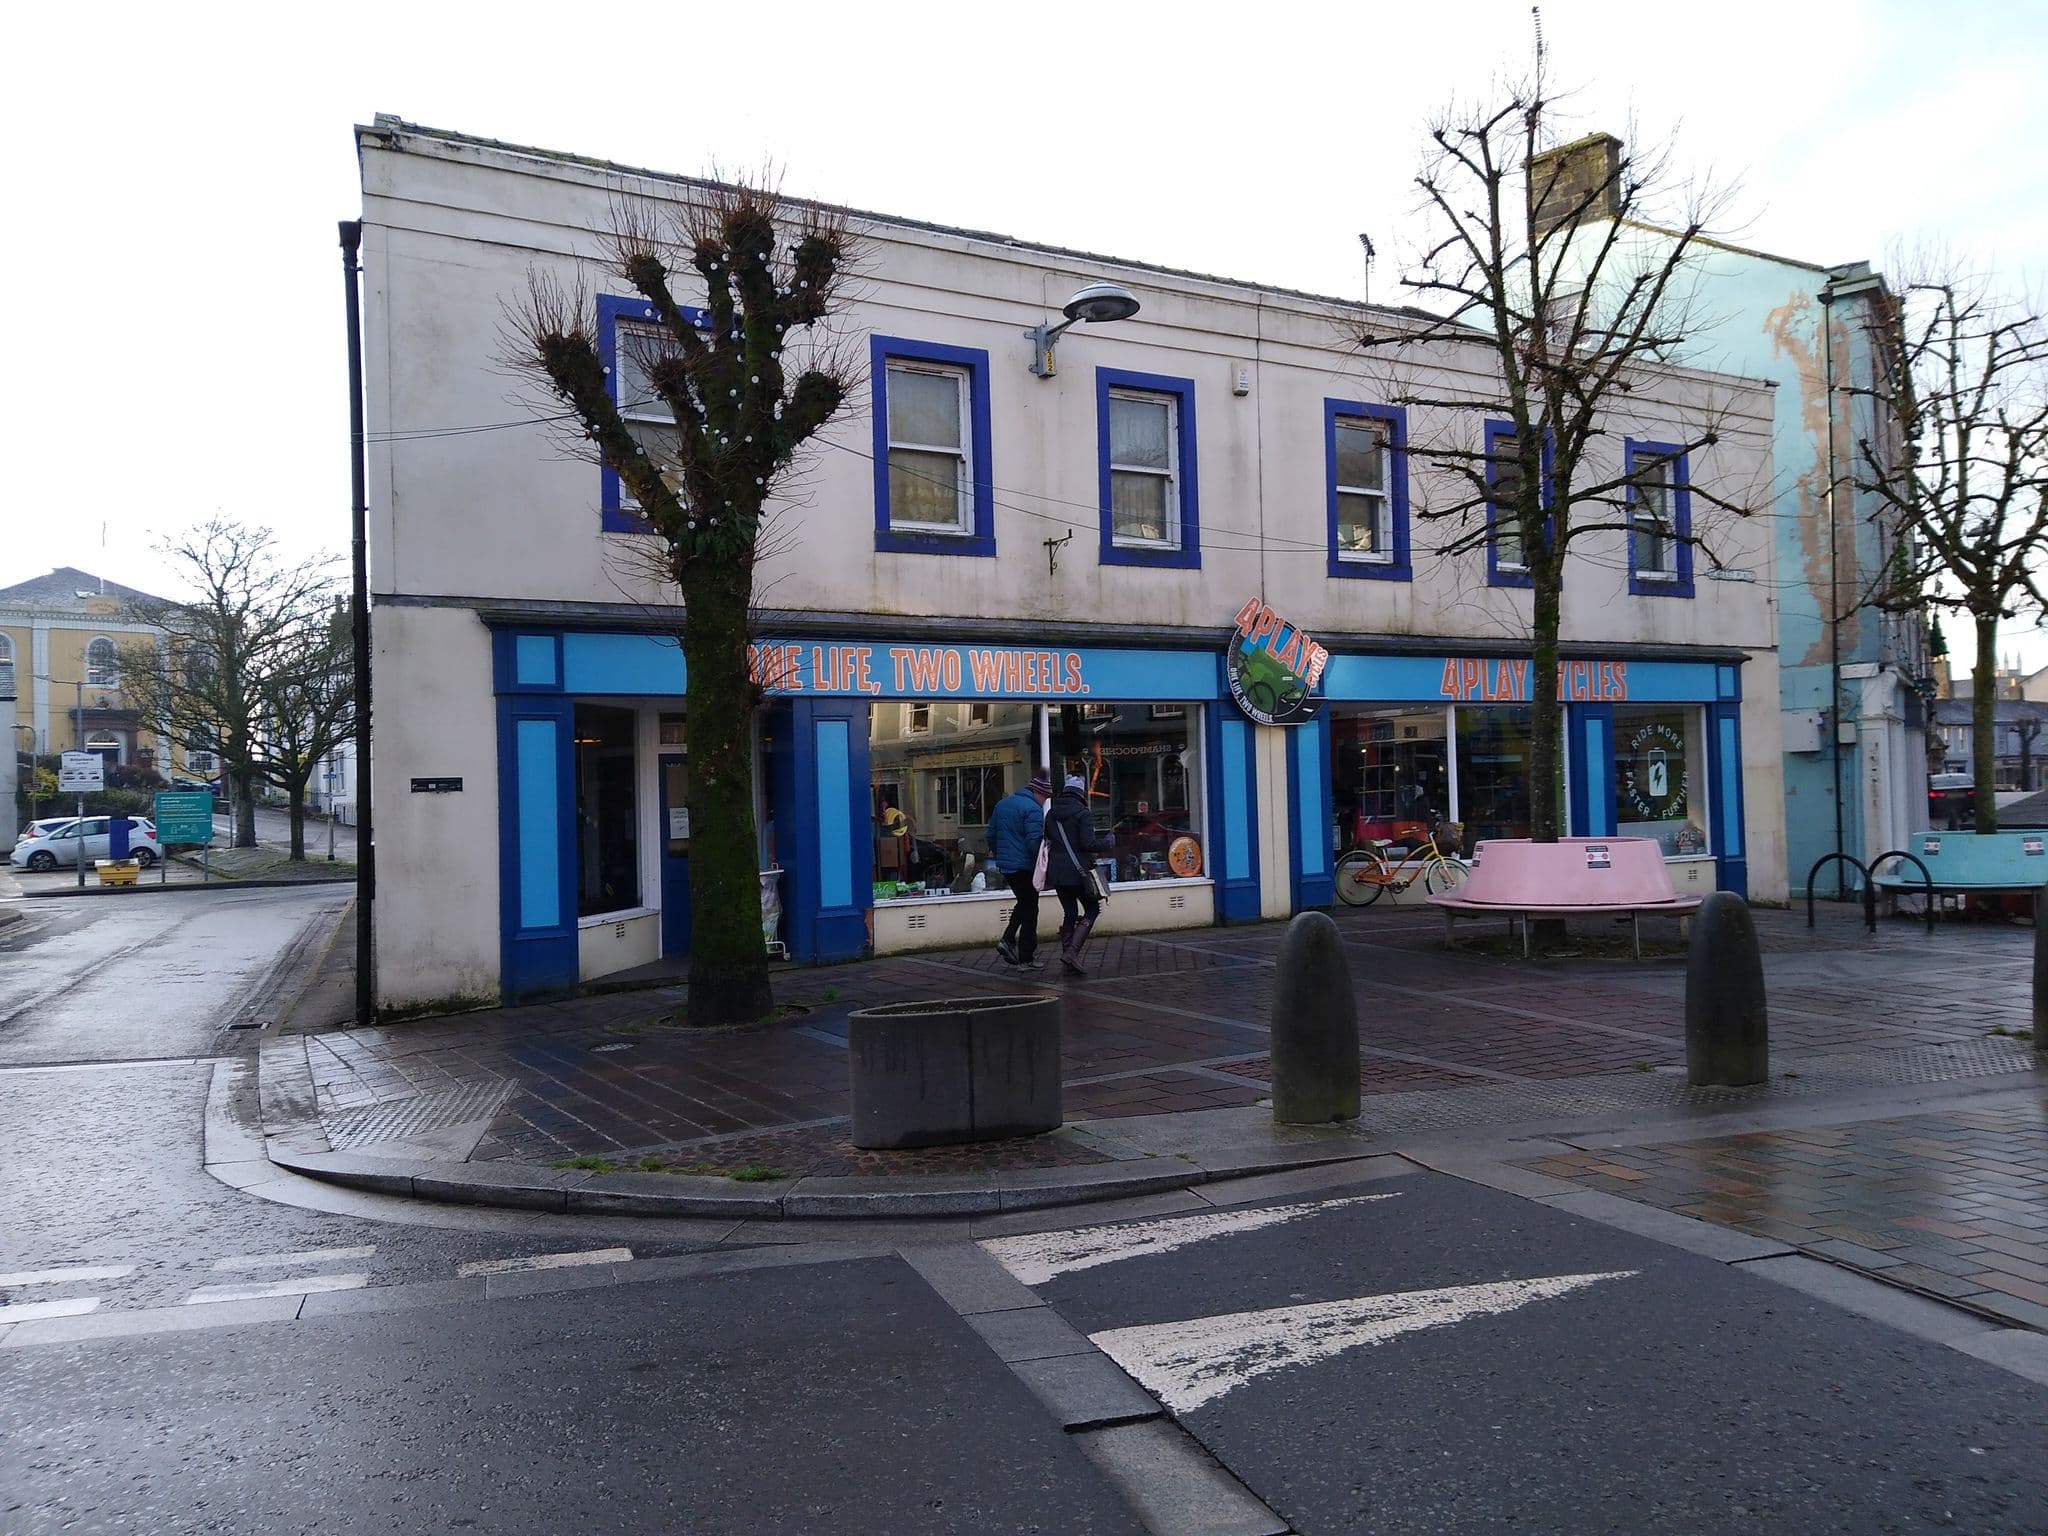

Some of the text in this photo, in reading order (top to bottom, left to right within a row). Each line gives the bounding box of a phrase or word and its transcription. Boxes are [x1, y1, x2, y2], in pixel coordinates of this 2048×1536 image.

[1234, 596, 1318, 678] 4PLAY
[812, 645, 881, 695] LIFE,
[890, 647, 962, 692] TWO
[968, 648, 1090, 693] WHEELS.
[1440, 657, 1626, 702] 4PLAY YCLES
[1240, 695, 1253, 711] TWO
[1631, 724, 1684, 750] RIDE MORE
[1626, 770, 1689, 819] FASTER FURTHER
